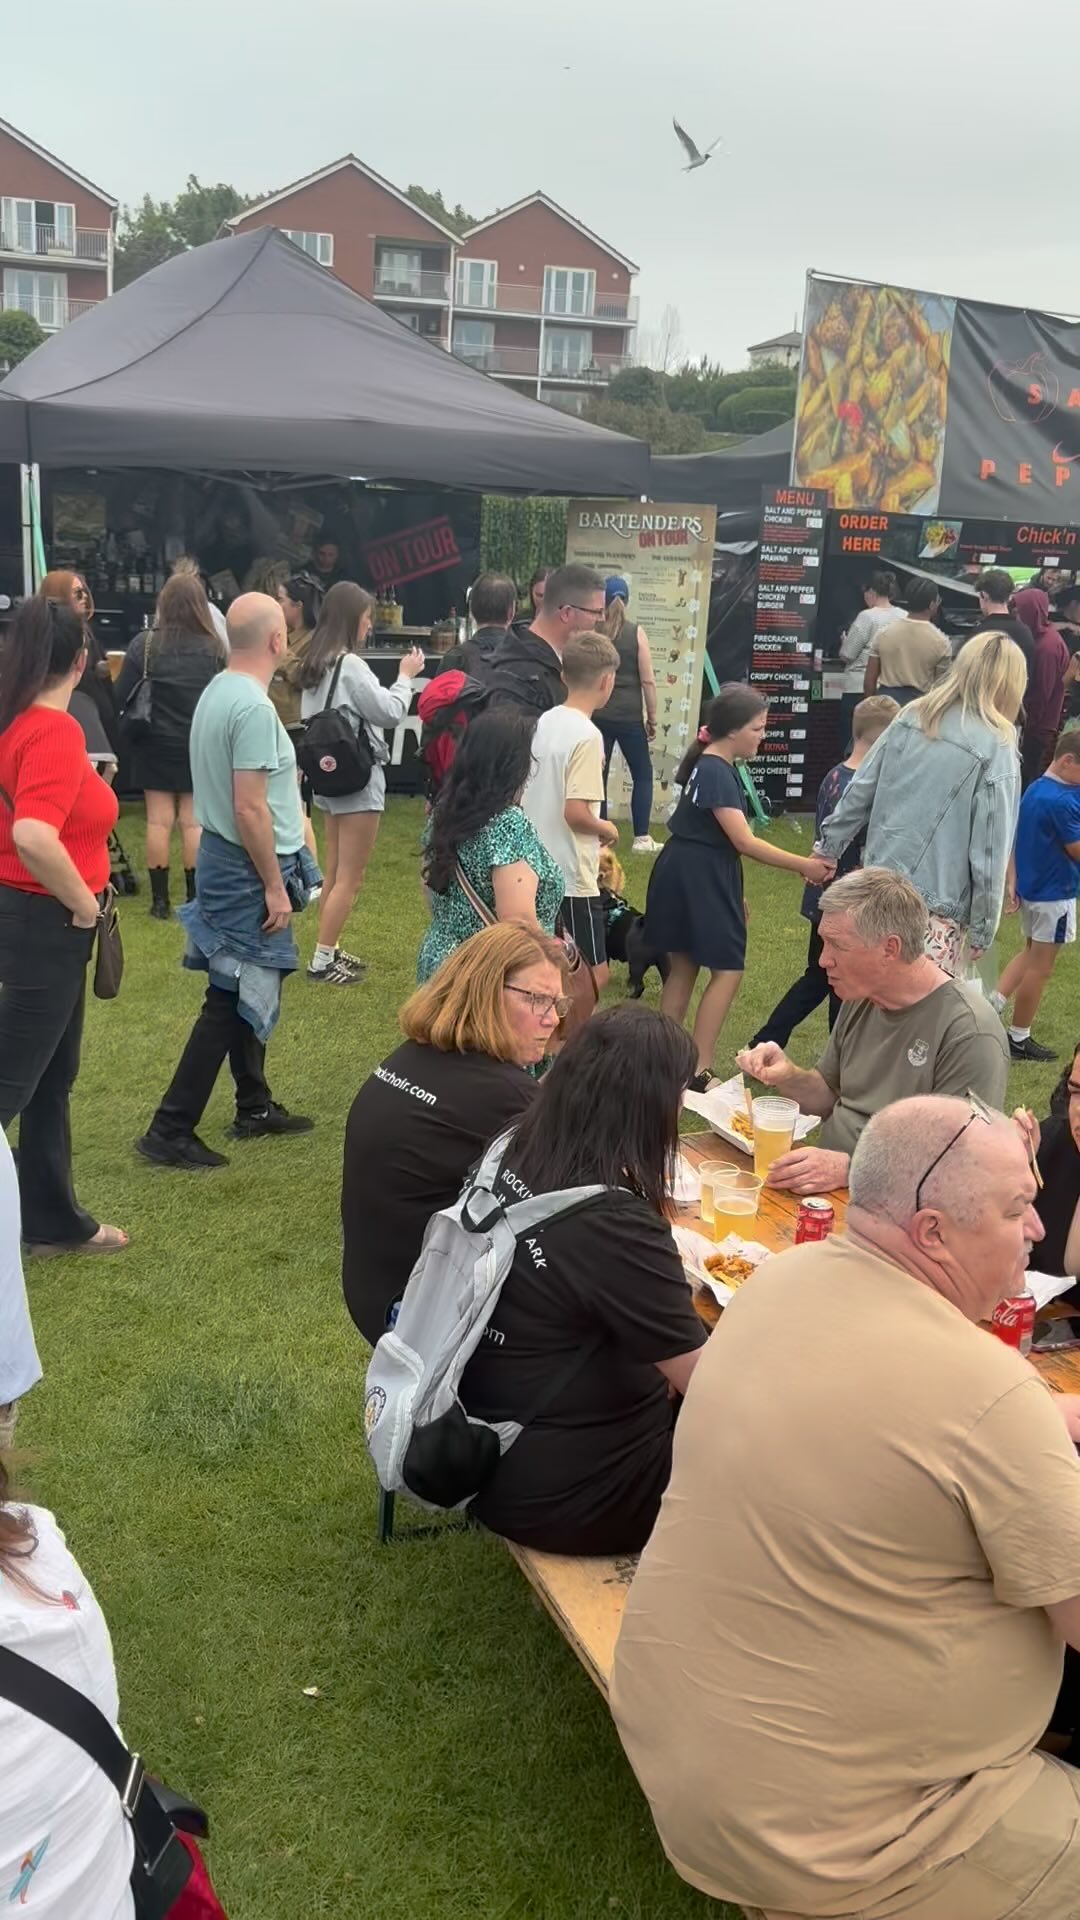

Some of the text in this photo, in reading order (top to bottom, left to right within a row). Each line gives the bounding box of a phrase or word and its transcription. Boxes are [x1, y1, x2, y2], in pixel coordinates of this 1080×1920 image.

[775, 489, 815, 505] MENU
[765, 506, 821, 517] SALT AND PEPPER
[764, 515, 792, 524] CHICKEN
[840, 514, 888, 530] ORDER
[578, 512, 709, 542] BARTENDERS
[639, 529, 688, 548] ON TOUR
[1016, 525, 1077, 545] Chick'n
[842, 535, 881, 552] HERE
[368, 527, 459, 582] ON TOUR
[761, 544, 818, 555] SALT AND PEPPER
[760, 554, 788, 563] PRAWNS
[758, 584, 814, 594] SALT AND PEPPER
[757, 592, 786, 601] CHICKEN
[757, 601, 784, 609] BURGER
[753, 634, 798, 643] FIRECRACKER
[753, 643, 782, 651] CHICKEN
[750, 672, 803, 681] CRISPY CHICKEN
[764, 743, 789, 752] EXTRAS
[767, 767, 791, 775] CHEESE
[525, 1238, 548, 1269] ARK
